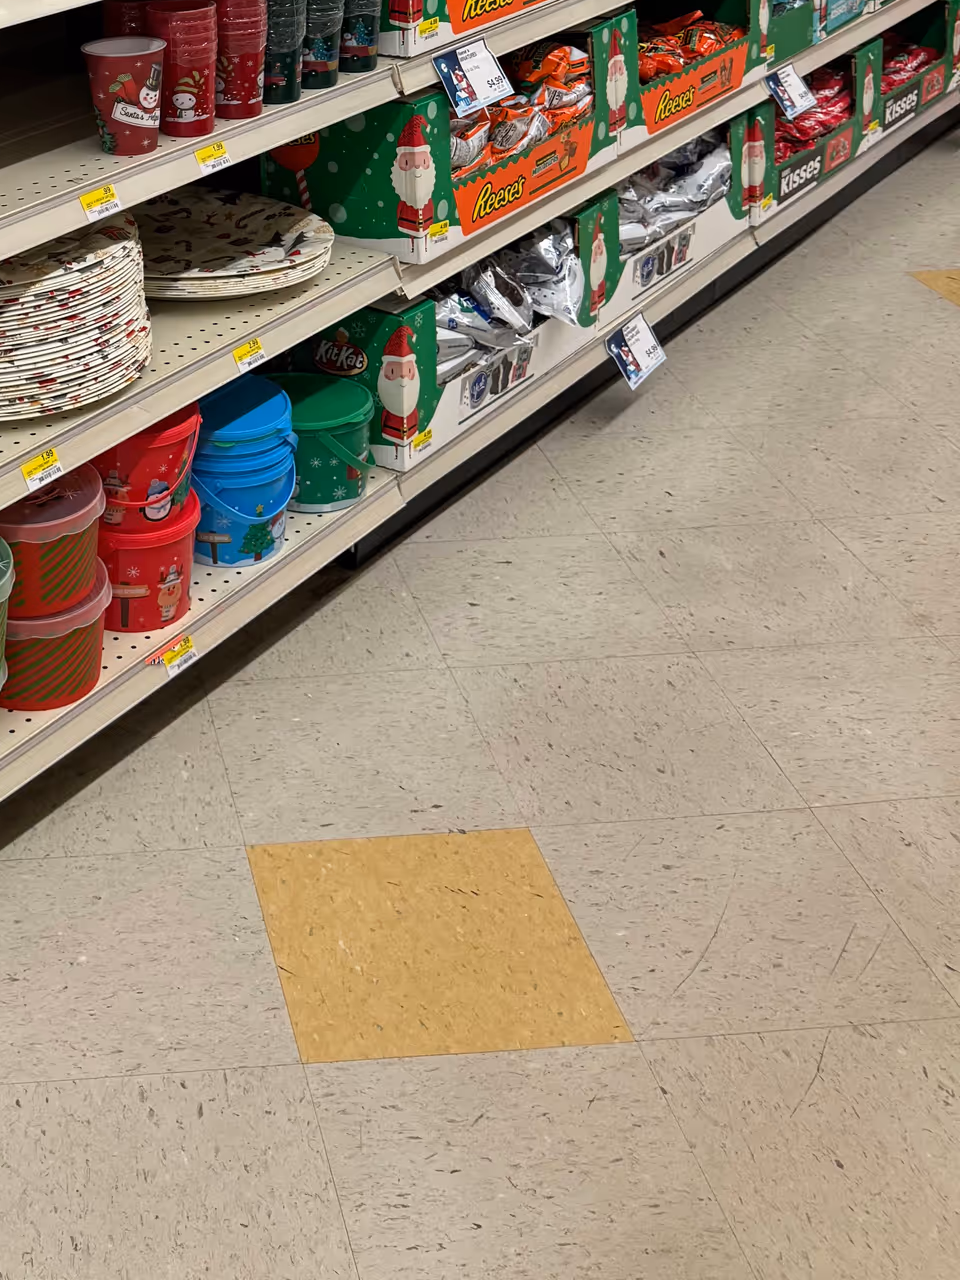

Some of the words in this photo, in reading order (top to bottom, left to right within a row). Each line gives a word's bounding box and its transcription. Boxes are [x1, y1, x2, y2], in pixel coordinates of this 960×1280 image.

[486, 75, 504, 89] $4.99
[653, 84, 696, 124] Reese's
[884, 89, 919, 124] KISSES
[212, 142, 224, 153] 1.99
[779, 155, 822, 197] KISSES
[102, 186, 112, 195] .99
[471, 174, 527, 224] Reese's
[247, 338, 259, 349] 2.99
[41, 449, 54, 462] 1.99
